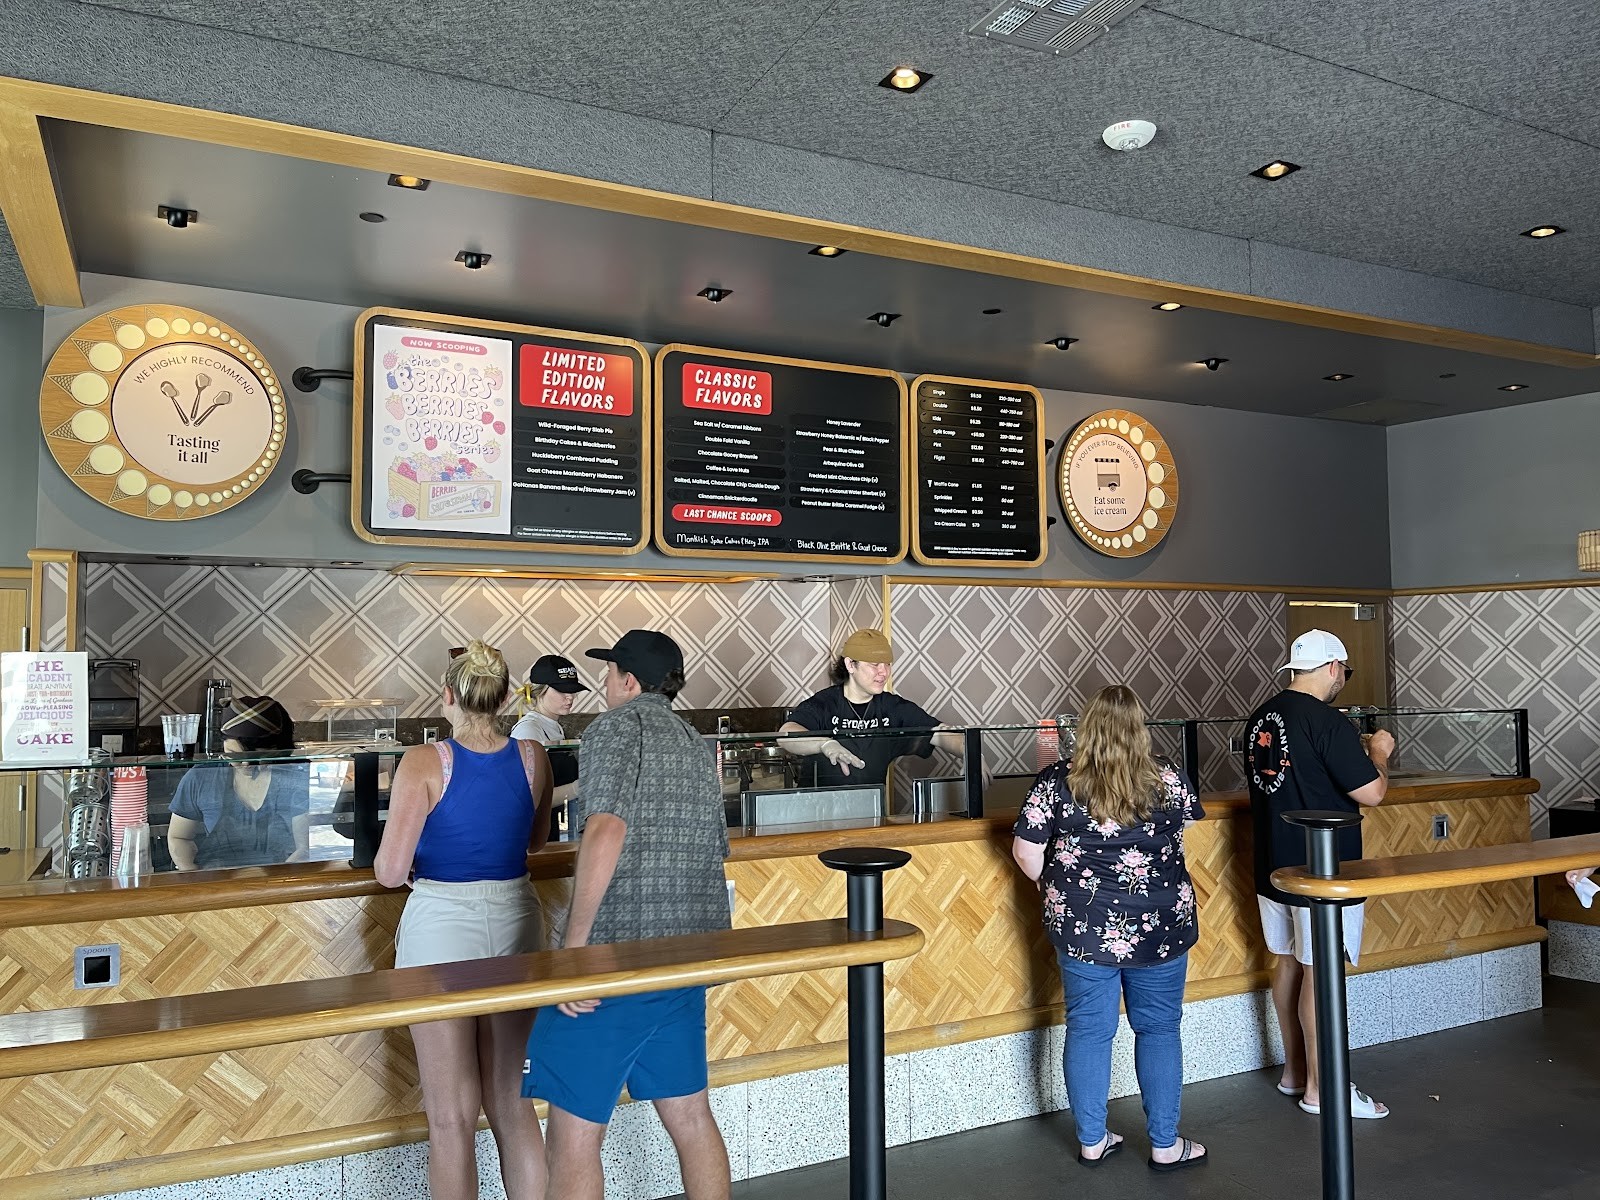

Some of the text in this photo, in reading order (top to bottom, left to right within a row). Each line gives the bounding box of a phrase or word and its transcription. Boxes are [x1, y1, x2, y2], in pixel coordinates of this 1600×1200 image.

[1114, 123, 1131, 131] FIRE
[410, 339, 480, 352] NOW SCOOPING
[409, 354, 432, 366] the
[542, 351, 606, 372] LIMITED
[134, 355, 255, 395] WE HIGHLY RECOMMEND
[542, 369, 606, 391] EDITION
[695, 369, 757, 389] CLASSIC
[394, 365, 496, 400] BERRIES
[541, 388, 614, 411] FLAVORS
[695, 388, 762, 409] FLAVORS
[401, 394, 488, 421] BERRIES
[405, 418, 484, 444] BERRIES
[577, 425, 591, 433] Berry
[714, 421, 721, 429] w/
[721, 422, 742, 430] Caramel
[796, 430, 820, 438] Strawberry
[168, 434, 220, 453] Tasting
[535, 436, 559, 445] Birthday
[583, 441, 616, 449] Blackberries
[456, 444, 494, 454] series
[698, 449, 722, 457] Chocolate
[1078, 449, 1088, 462] YOU
[1088, 441, 1101, 452] EVER
[178, 450, 208, 464] it all
[532, 452, 565, 461] Huckleberry
[566, 455, 595, 463] Cornbread
[563, 470, 596, 479] Marionberry
[692, 478, 710, 486] Malted,
[432, 486, 456, 498] BERRIES
[800, 486, 824, 494] Strawberry
[1094, 496, 1126, 505] Eat some
[684, 509, 772, 522] LAST CHANCE SCOOPS
[1094, 506, 1127, 515] ice cream
[676, 534, 708, 544] Monkish
[797, 540, 815, 549] Black
[830, 541, 851, 551] Brittle
[852, 542, 858, 551] &
[16, 711, 73, 720] DELICIOUS
[1249, 712, 1289, 753] GOOD COMPANY
[17, 734, 73, 744] CAKE
